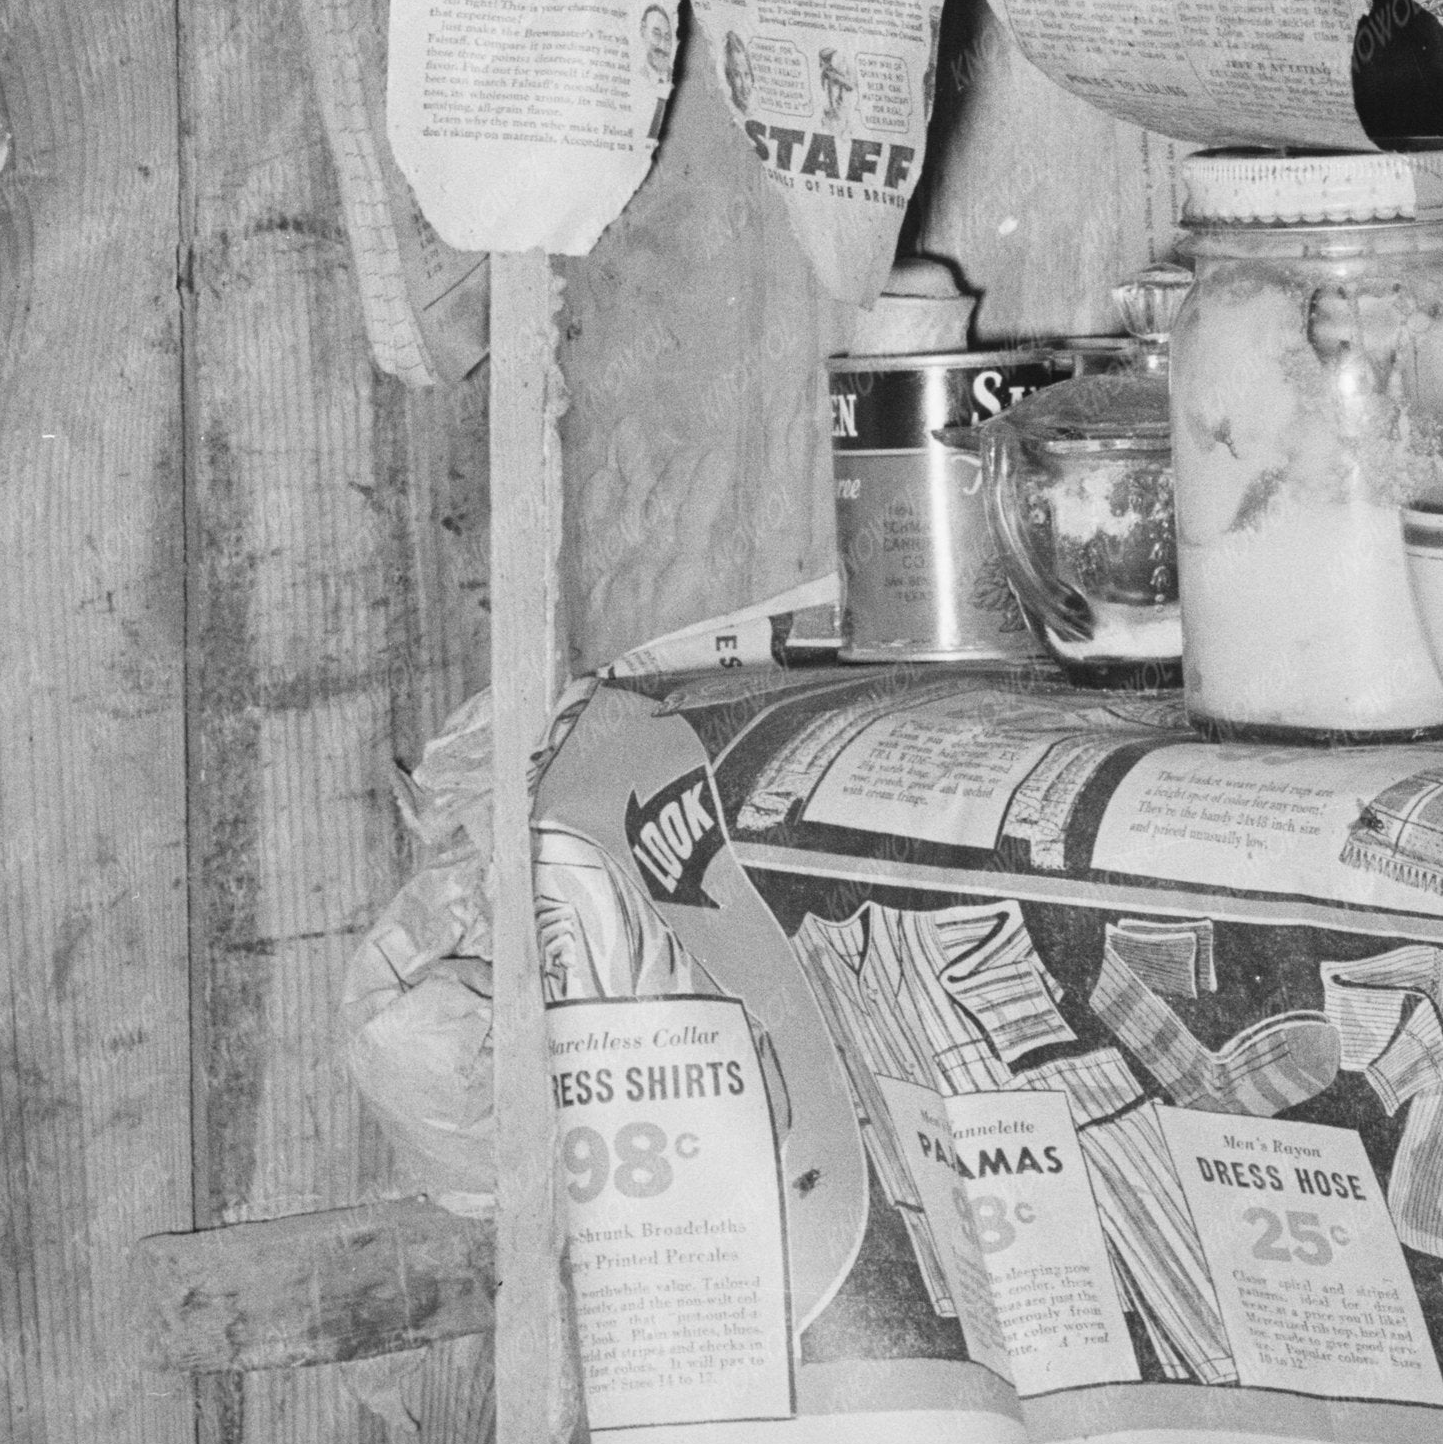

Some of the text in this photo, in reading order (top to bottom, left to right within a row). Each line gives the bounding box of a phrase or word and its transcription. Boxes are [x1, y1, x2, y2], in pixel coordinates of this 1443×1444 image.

[745, 118, 916, 190] STAFF
[805, 178, 854, 199] OF THE
[634, 780, 717, 895] LOOK
[653, 1025, 719, 1048] Collar
[625, 1060, 745, 1102] SHIRTS
[1222, 1134, 1322, 1160] Men's Rayon
[1196, 1156, 1367, 1201] DRESS HOSE
[642, 1218, 747, 1238] Broadcloths
[596, 1247, 739, 1270] Printed Percales
